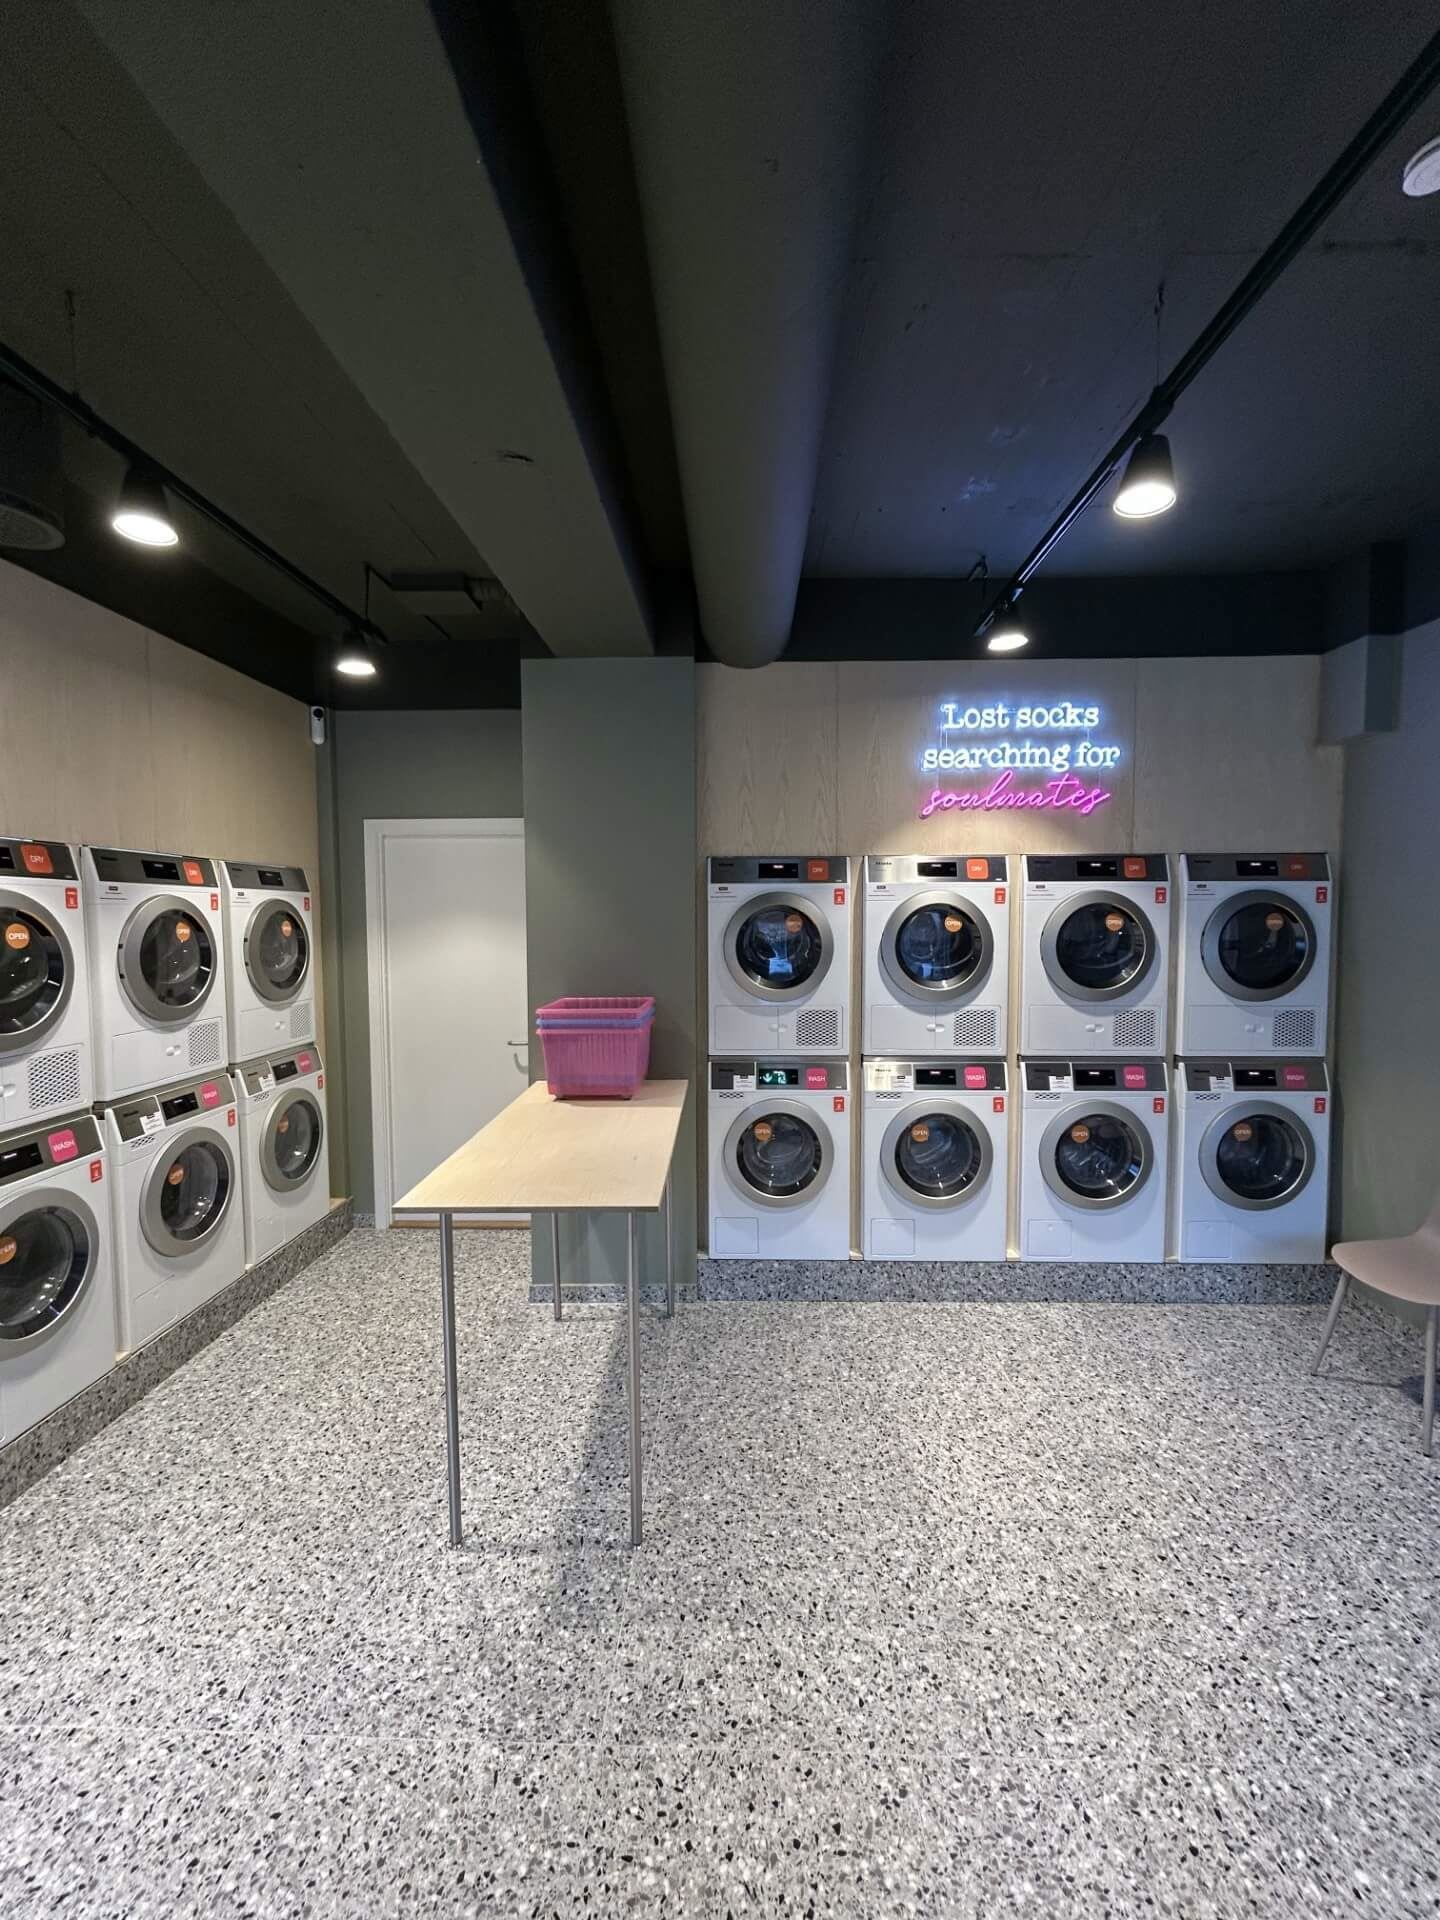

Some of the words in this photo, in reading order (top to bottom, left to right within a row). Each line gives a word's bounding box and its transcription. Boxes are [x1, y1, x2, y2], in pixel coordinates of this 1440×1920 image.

[940, 703, 1010, 729] Lost
[1015, 702, 1100, 728] socks
[923, 741, 1072, 773] searching
[1075, 742, 1121, 768] for
[921, 769, 1111, 816] soulmates
[30, 854, 44, 864] DRY
[8, 932, 28, 940] OPEN
[53, 1139, 75, 1152] WASH
